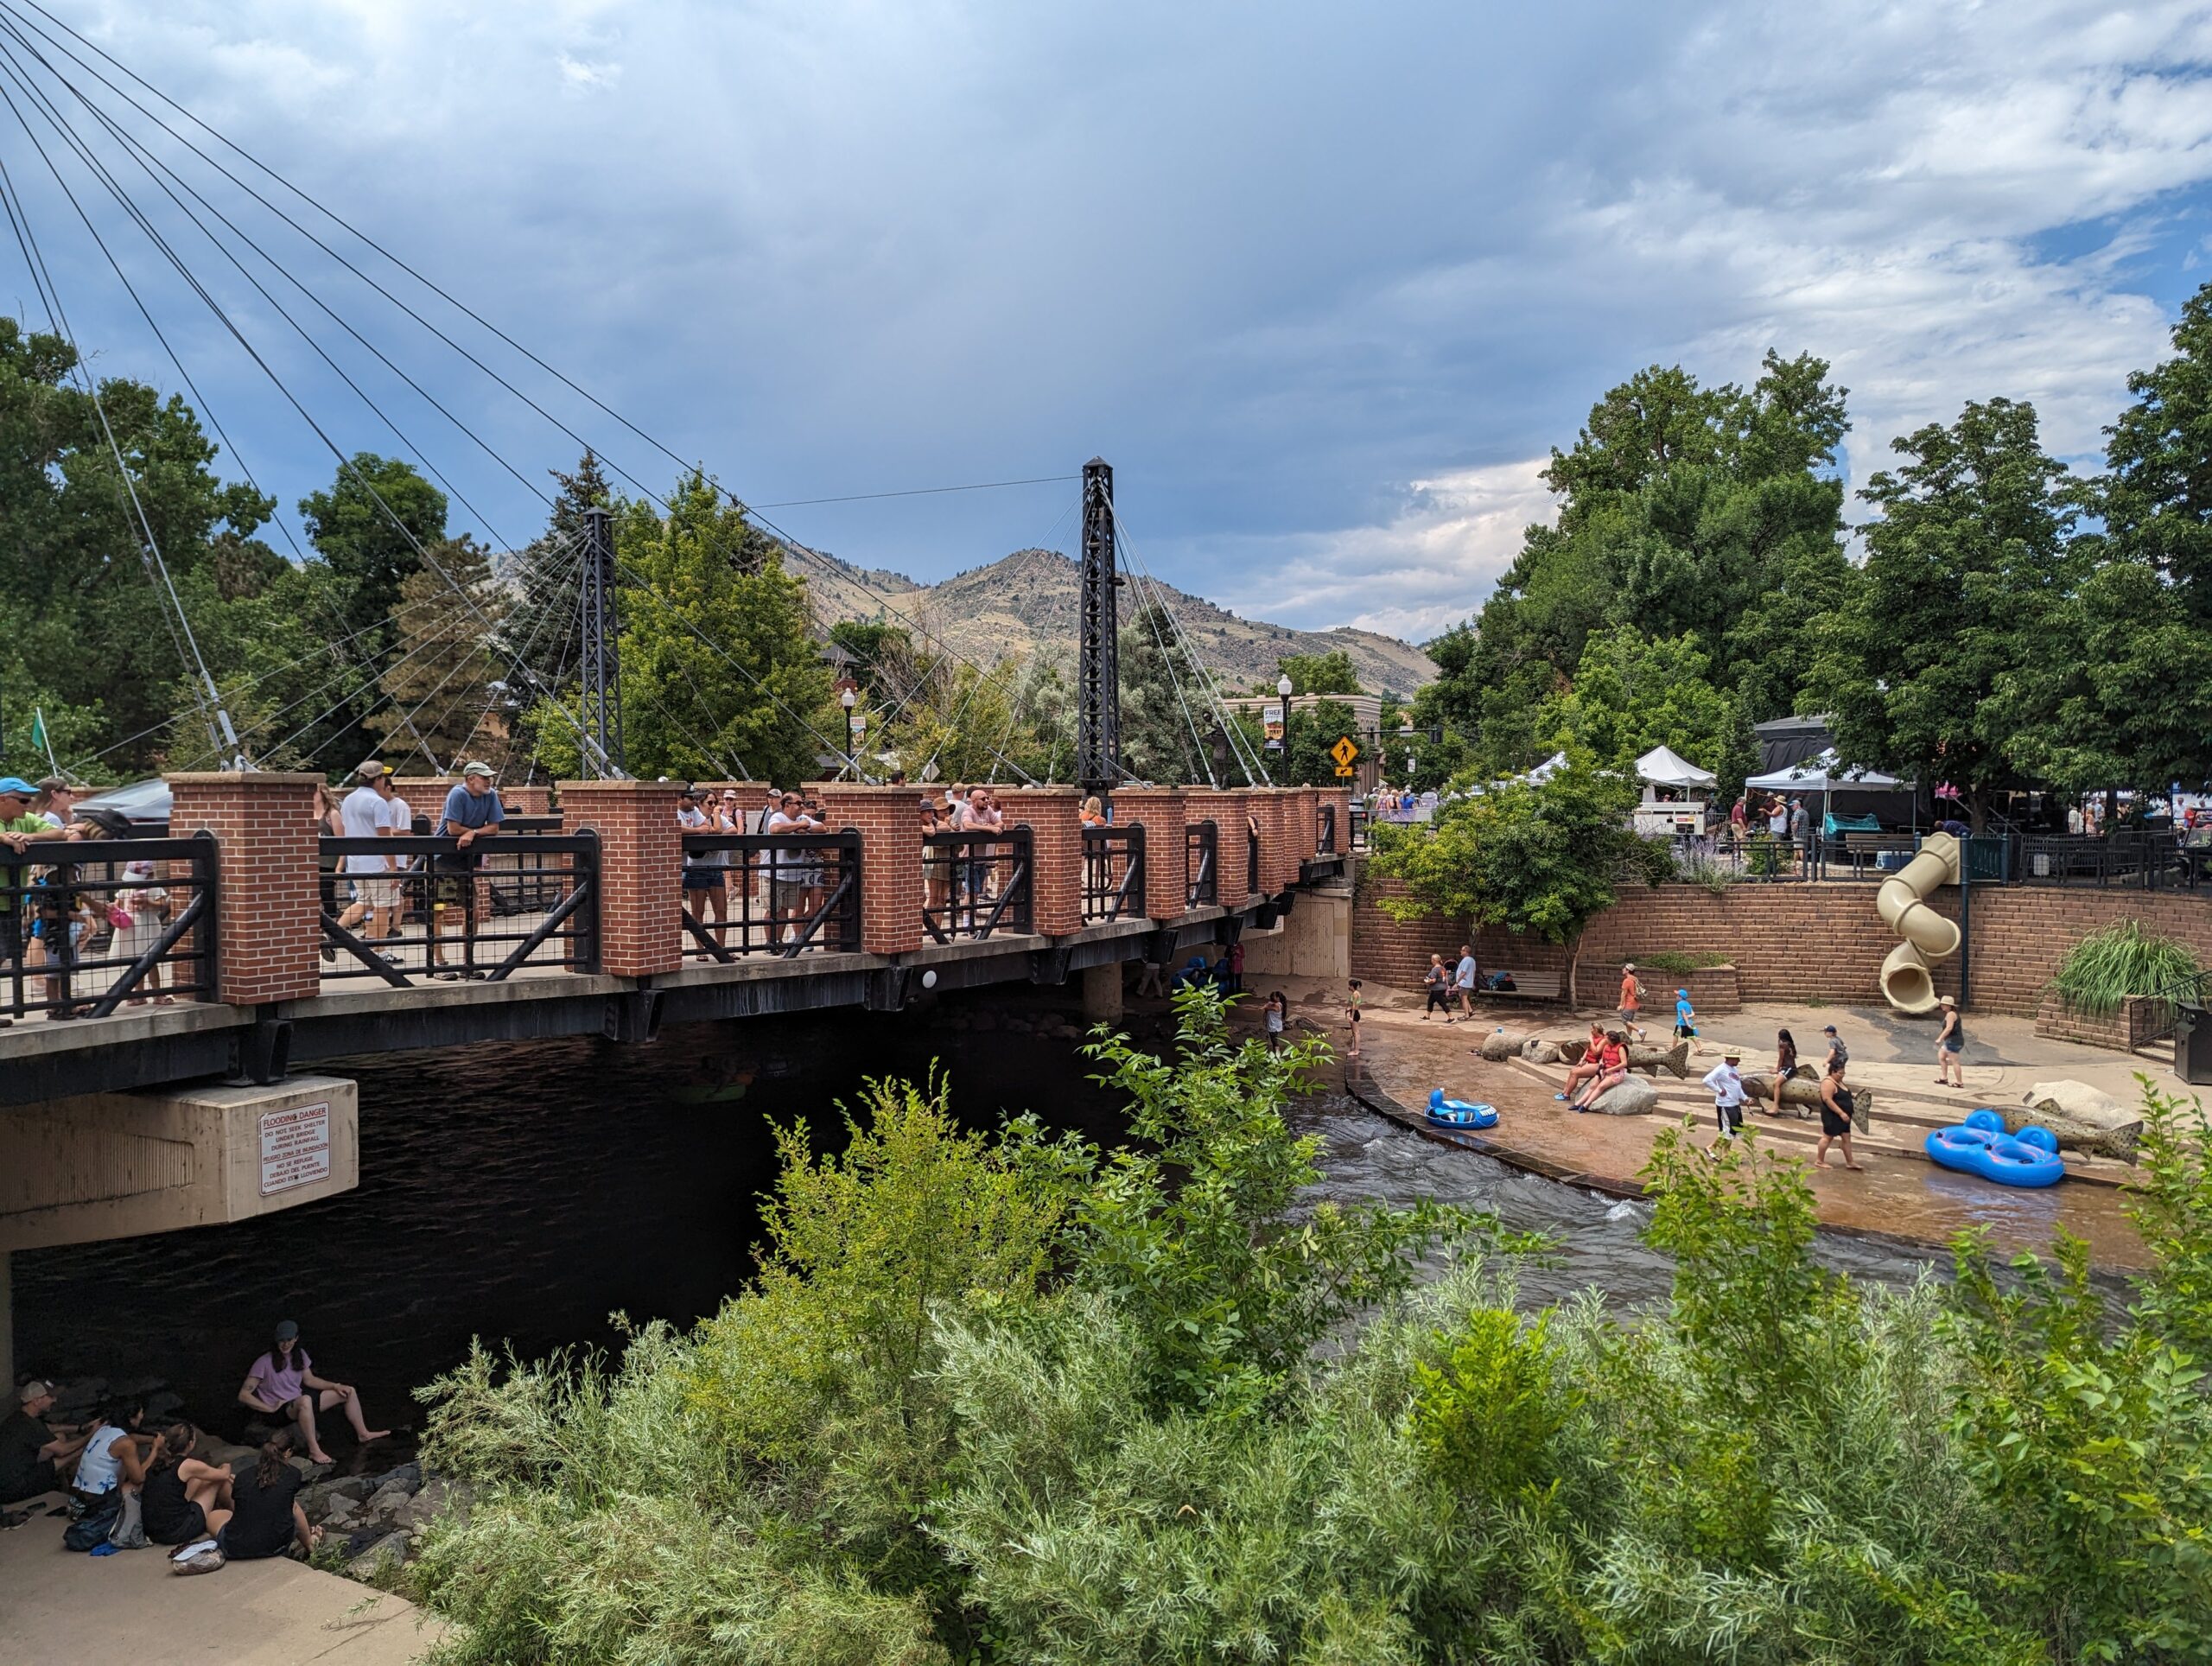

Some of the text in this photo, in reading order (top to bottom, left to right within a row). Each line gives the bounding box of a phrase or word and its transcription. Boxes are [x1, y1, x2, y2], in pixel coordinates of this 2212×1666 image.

[264, 1107, 326, 1127] FLOODING DANGER
[304, 1120, 325, 1128] SHELTER
[296, 1129, 315, 1138] BRIDGE
[271, 1136, 319, 1151] DURING RAINFALL
[263, 1154, 280, 1162] PELIGRO
[293, 1156, 314, 1165] REFUGIE
[270, 1169, 289, 1179] DEBAJO
[302, 1161, 320, 1170] PUENTE
[264, 1177, 286, 1188] CUANDO
[300, 1167, 328, 1179] LLOVIENDO
